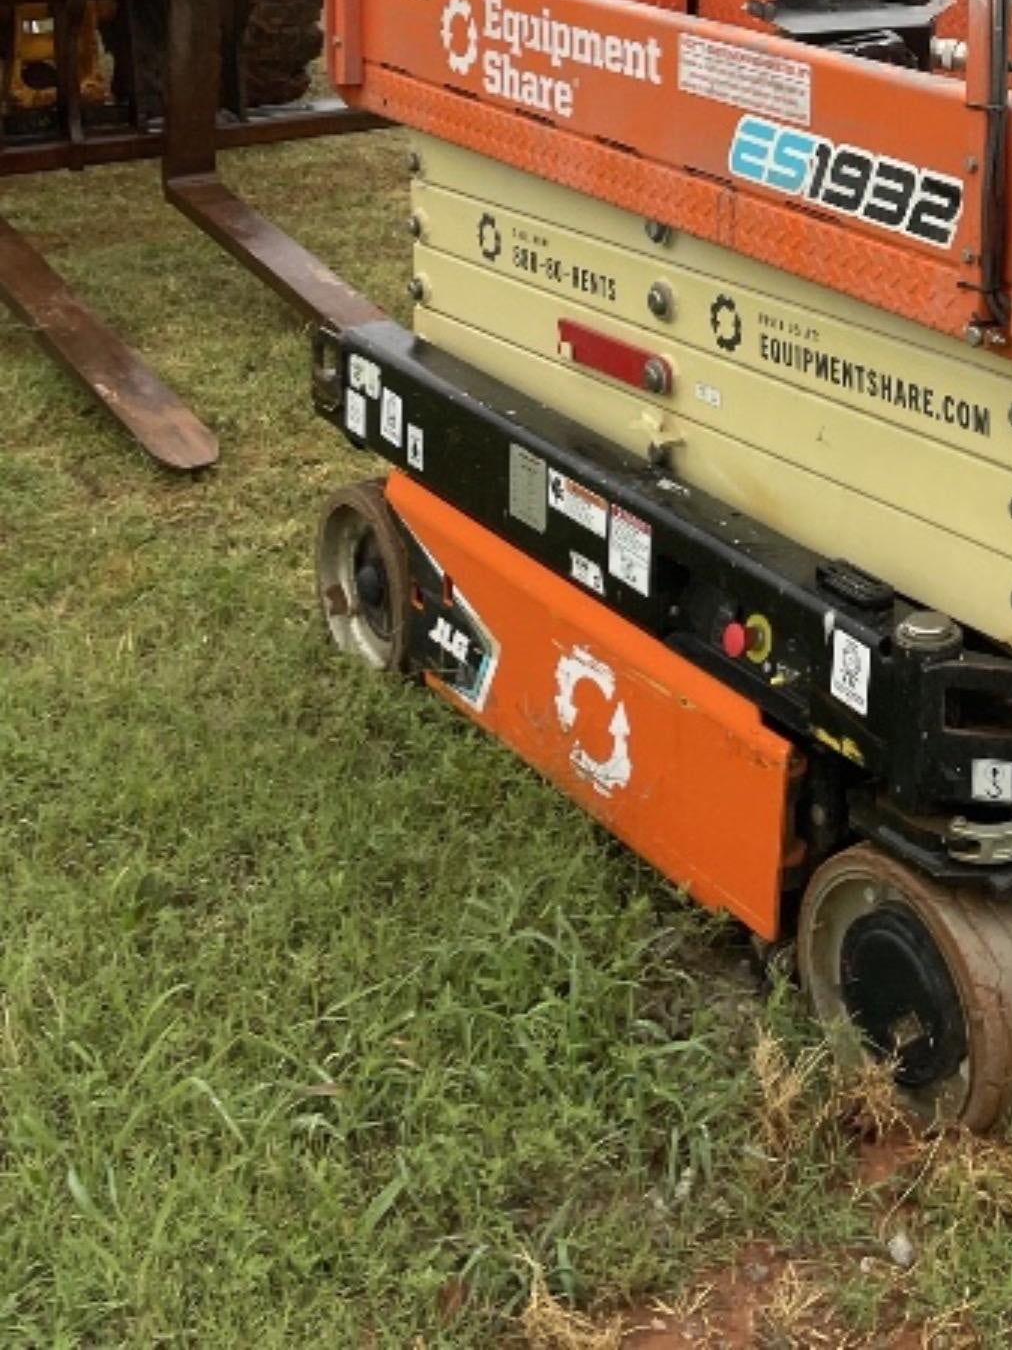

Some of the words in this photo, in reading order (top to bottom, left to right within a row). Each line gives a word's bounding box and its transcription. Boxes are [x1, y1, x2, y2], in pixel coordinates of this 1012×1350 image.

[482, 49, 574, 118] Share
[728, 114, 964, 250] ES1932
[759, 332, 991, 438] EQUIPMENTSHARE.COM
